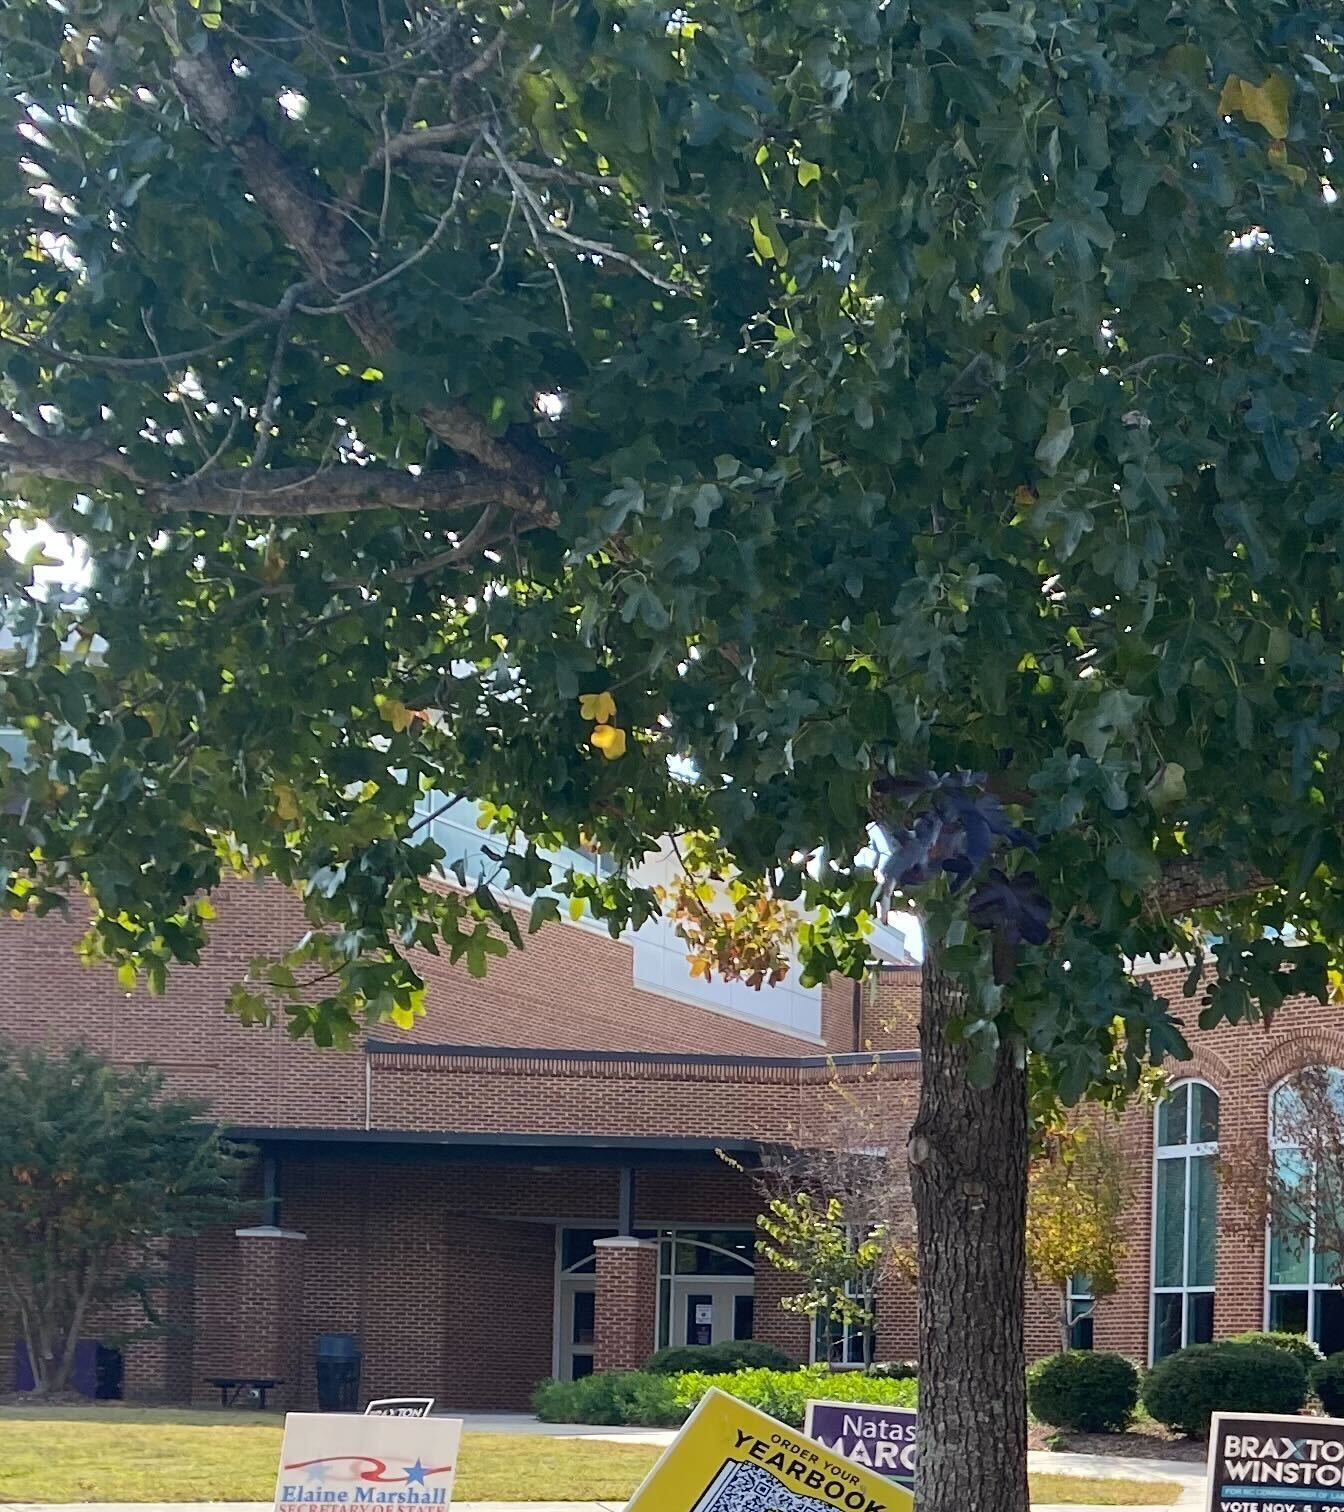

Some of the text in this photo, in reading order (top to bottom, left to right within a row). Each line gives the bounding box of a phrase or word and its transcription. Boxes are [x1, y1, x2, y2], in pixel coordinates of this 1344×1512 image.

[843, 1414, 917, 1442] Natas
[771, 1434, 861, 1486] ORDER YOUR
[816, 1435, 916, 1471] MARC
[282, 1485, 446, 1504] Elaine Marshall
